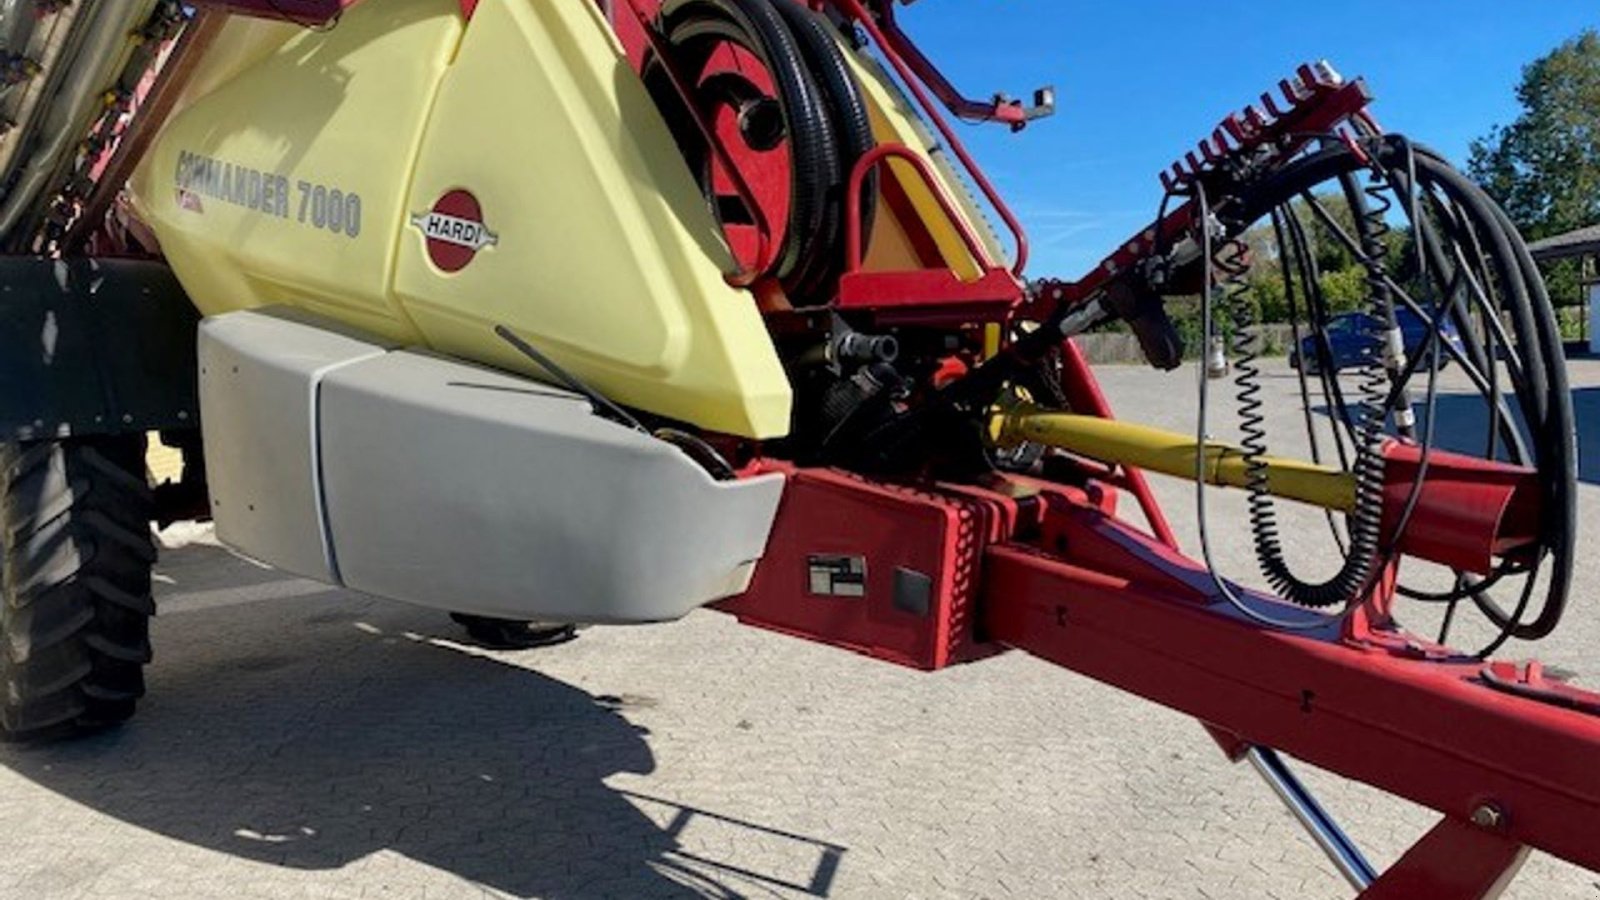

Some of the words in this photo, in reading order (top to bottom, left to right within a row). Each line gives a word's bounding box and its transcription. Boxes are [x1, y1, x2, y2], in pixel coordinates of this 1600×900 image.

[175, 150, 289, 218] COMMANDER
[298, 180, 361, 238] 7000
[427, 215, 481, 244] HARDI
